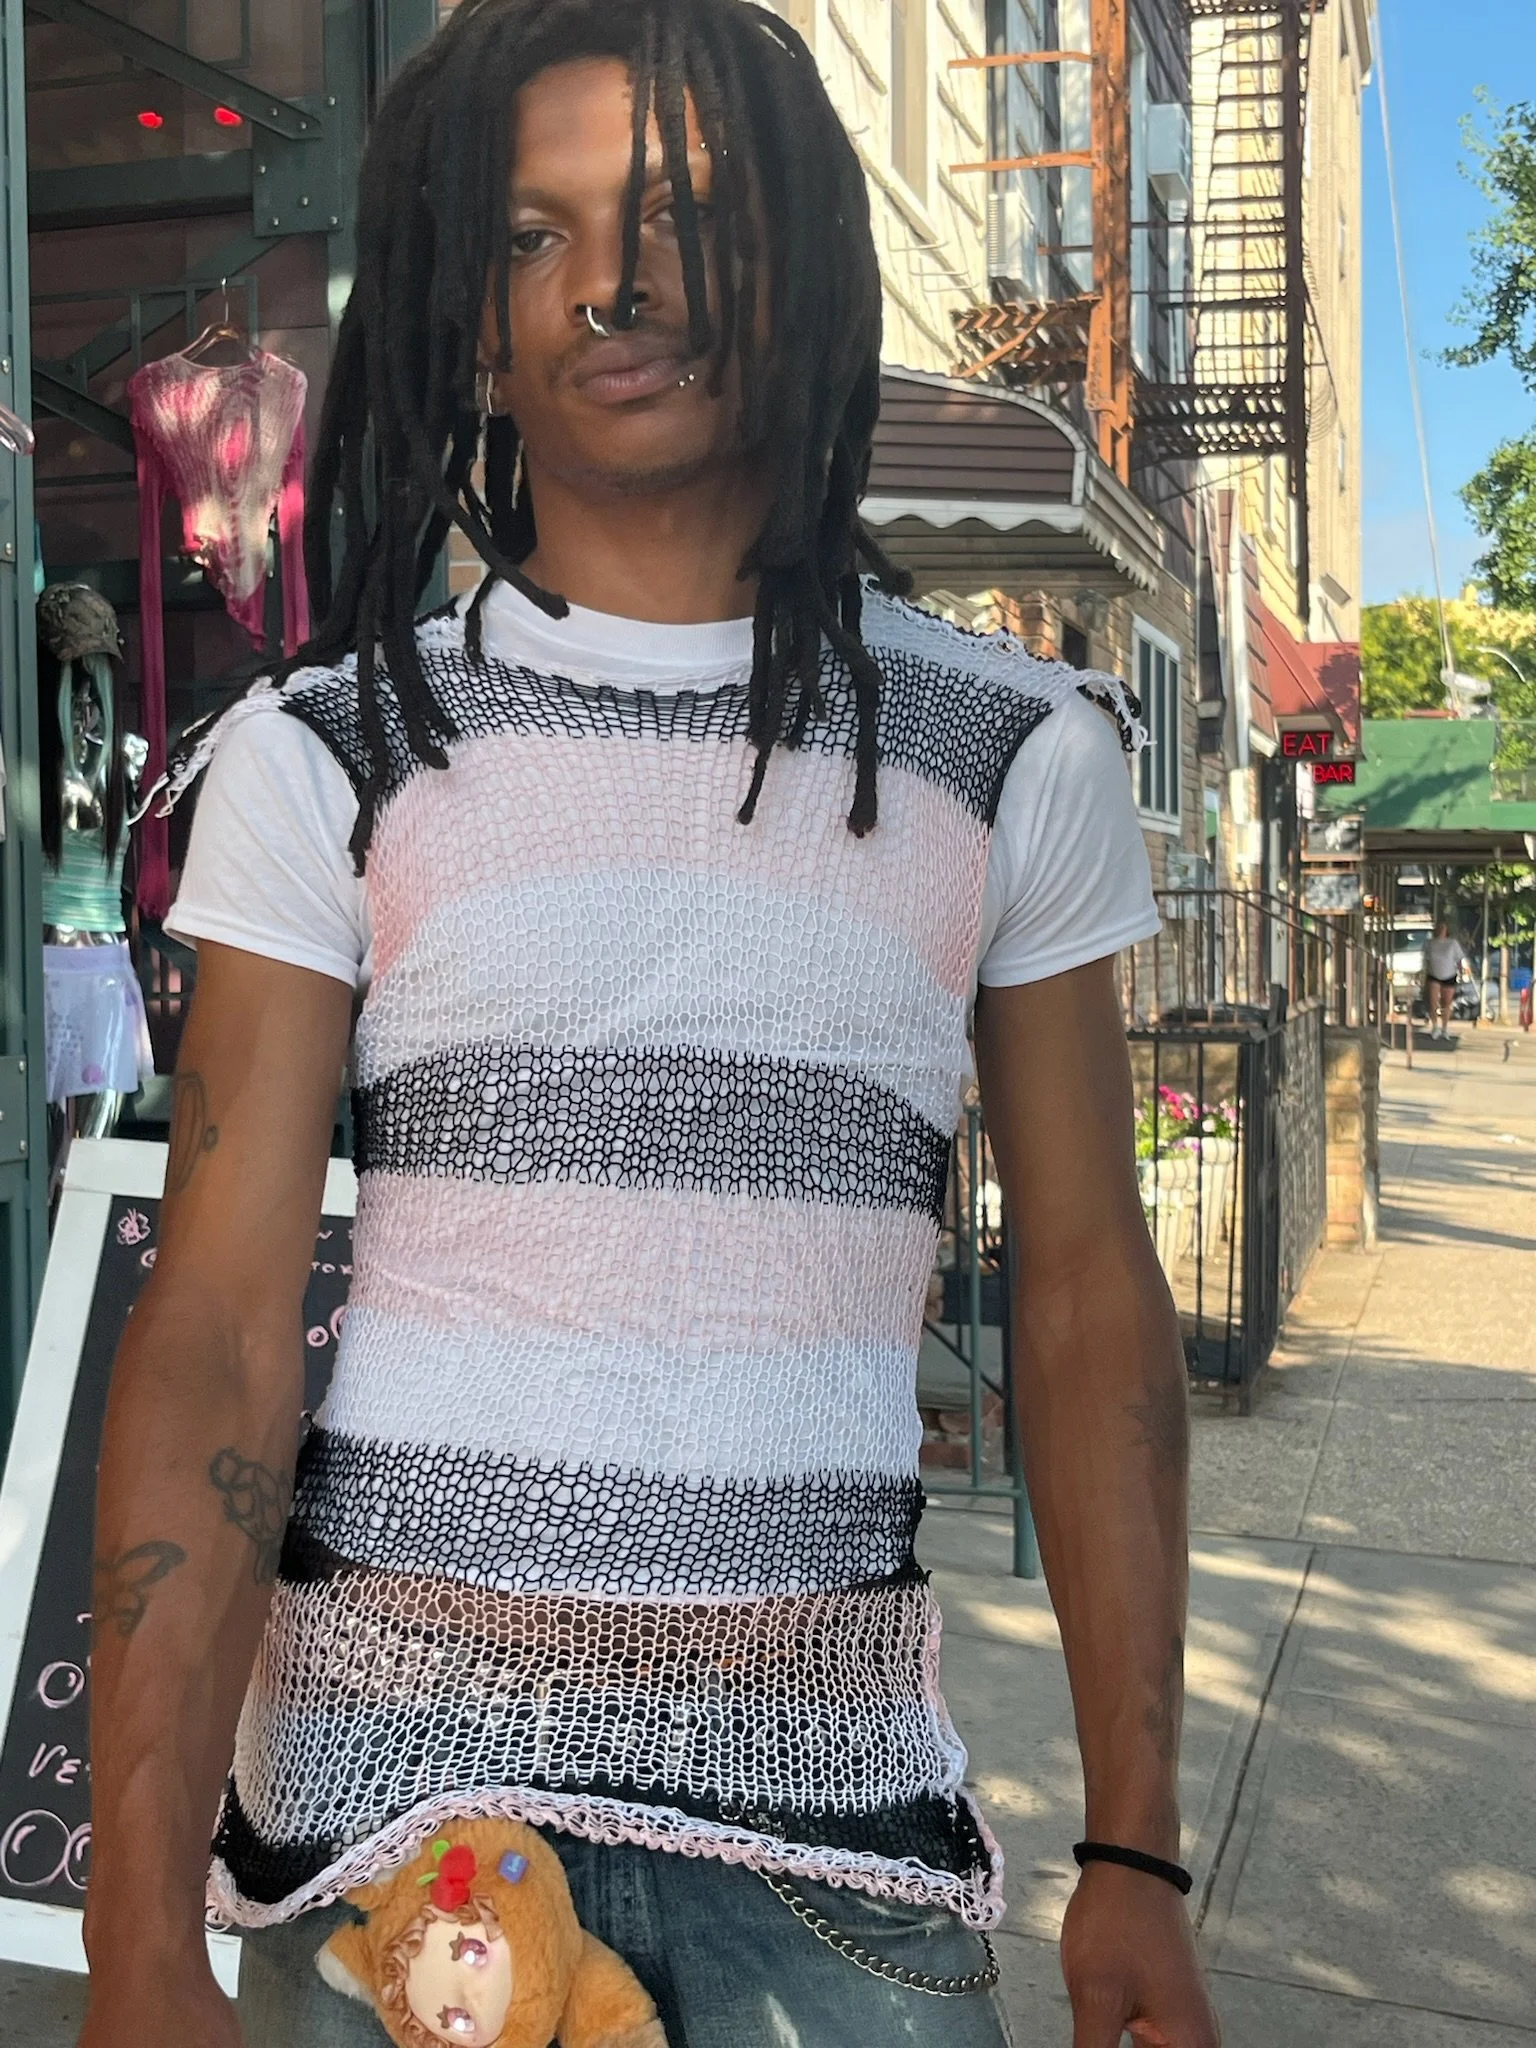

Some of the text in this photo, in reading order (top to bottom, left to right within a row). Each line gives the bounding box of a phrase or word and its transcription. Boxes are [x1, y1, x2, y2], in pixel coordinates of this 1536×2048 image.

[1282, 733, 1331, 757] EAT
[1312, 763, 1353, 784] BAR
[28, 1742, 92, 1784] VE
